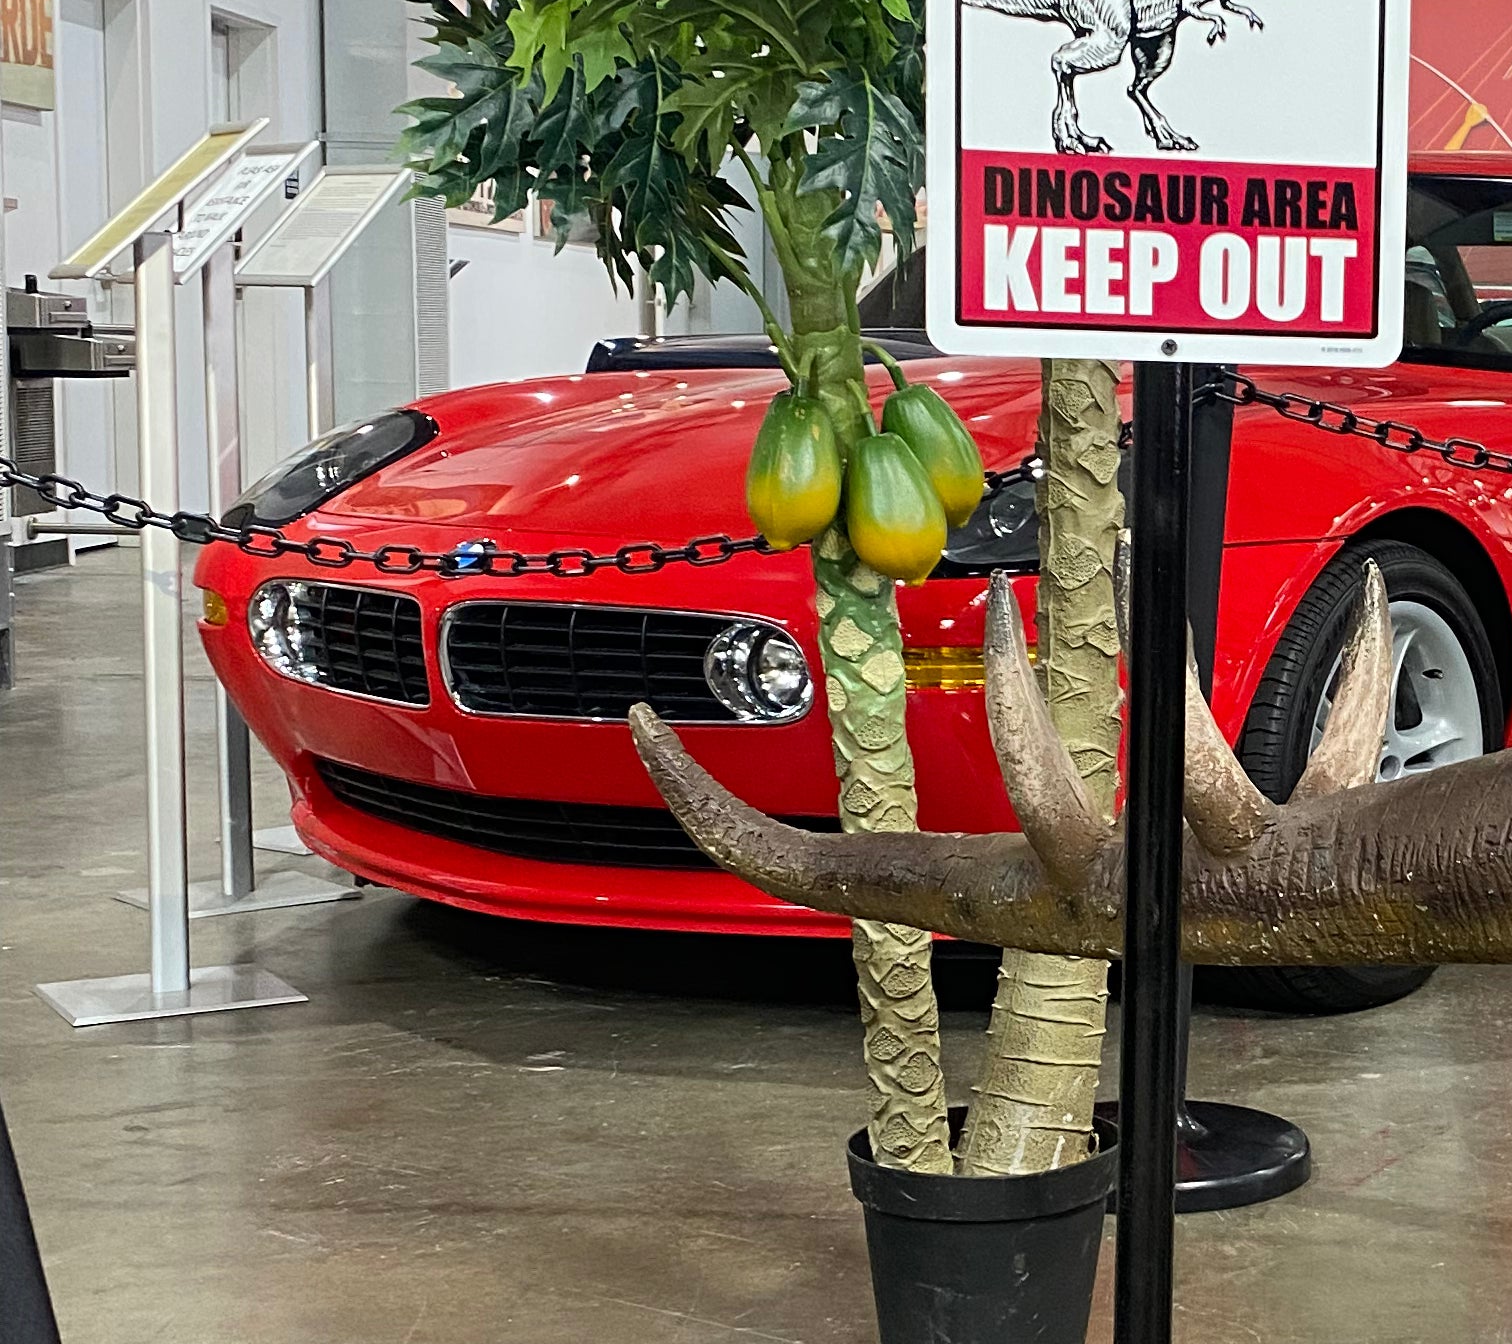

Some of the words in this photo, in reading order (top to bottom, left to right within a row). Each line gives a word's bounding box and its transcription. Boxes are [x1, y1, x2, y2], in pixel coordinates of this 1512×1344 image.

[983, 165, 1229, 226] DINOSAUR
[1240, 178, 1359, 231] AREA
[983, 223, 1179, 316] KEEP
[1199, 232, 1358, 322] OUT
